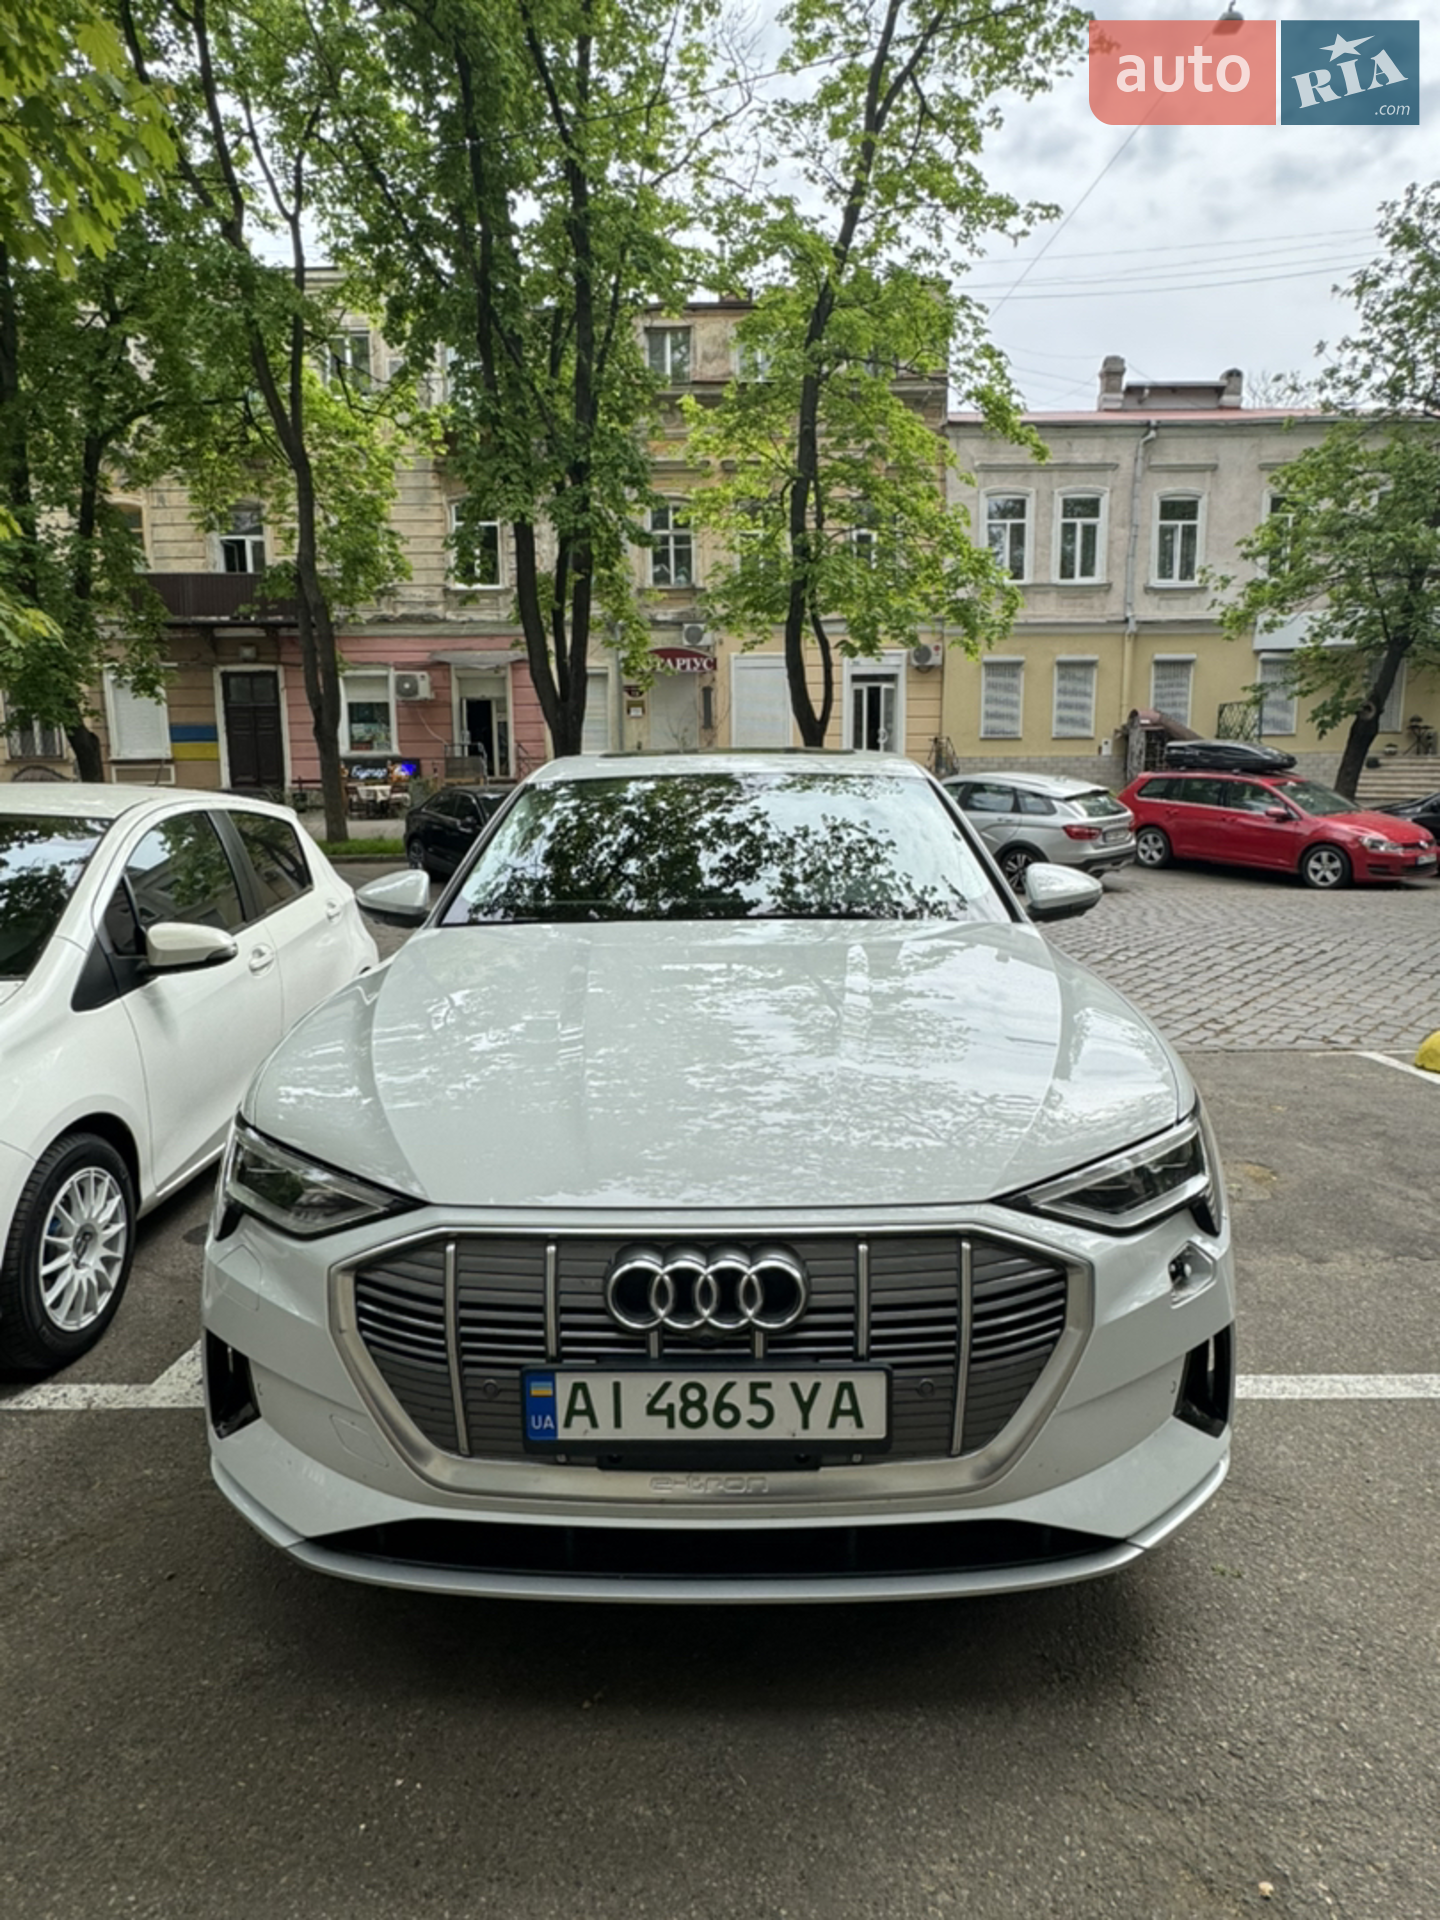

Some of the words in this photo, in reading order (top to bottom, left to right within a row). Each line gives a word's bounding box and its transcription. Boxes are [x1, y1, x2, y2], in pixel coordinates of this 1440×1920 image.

[562, 1381, 622, 1430] AI
[645, 1381, 775, 1430] 4865
[788, 1381, 865, 1430] YA
[530, 1414, 555, 1430] UA
[649, 1476, 769, 1494] e-tron
